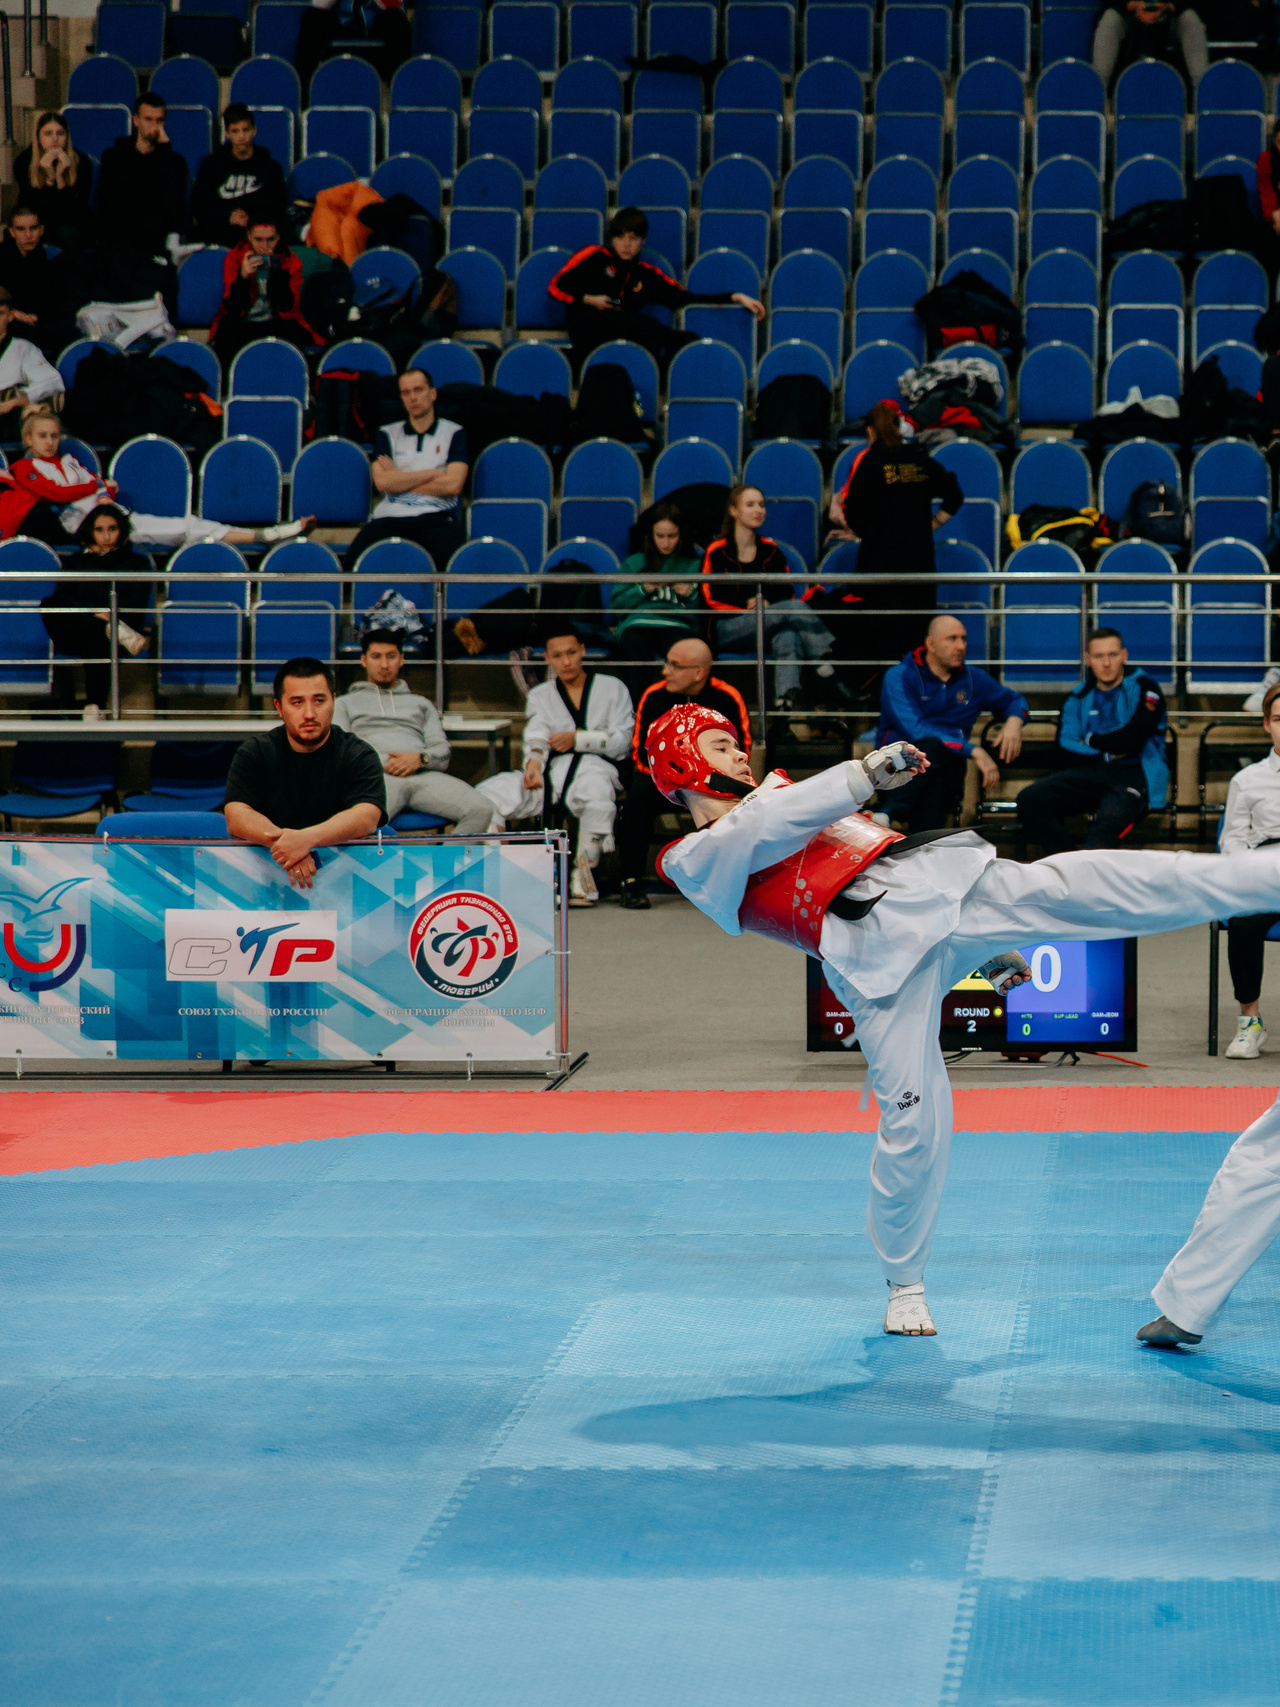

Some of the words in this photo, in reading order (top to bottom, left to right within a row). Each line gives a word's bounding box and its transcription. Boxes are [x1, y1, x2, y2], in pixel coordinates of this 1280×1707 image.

[417, 897, 457, 935] ФЕДЕРАЦИЯ
[503, 924, 514, 943] ВТФ
[1031, 945, 1061, 993] 0
[438, 980, 495, 996] ЛЮБЕРЦЫ
[24, 1004, 111, 1015] СТУЕНЧЕСКИЙ
[178, 1007, 211, 1016] СОЮЗ
[213, 1007, 280, 1016] ТХЭКВОДО
[283, 1007, 328, 1016] РОССИИ
[524, 1008, 547, 1016] ВТФ
[954, 1007, 990, 1017] ROUND
[834, 1022, 844, 1035] 0
[967, 1020, 977, 1032] 2
[1022, 1023, 1031, 1036] 0
[1100, 1023, 1110, 1035] 0
